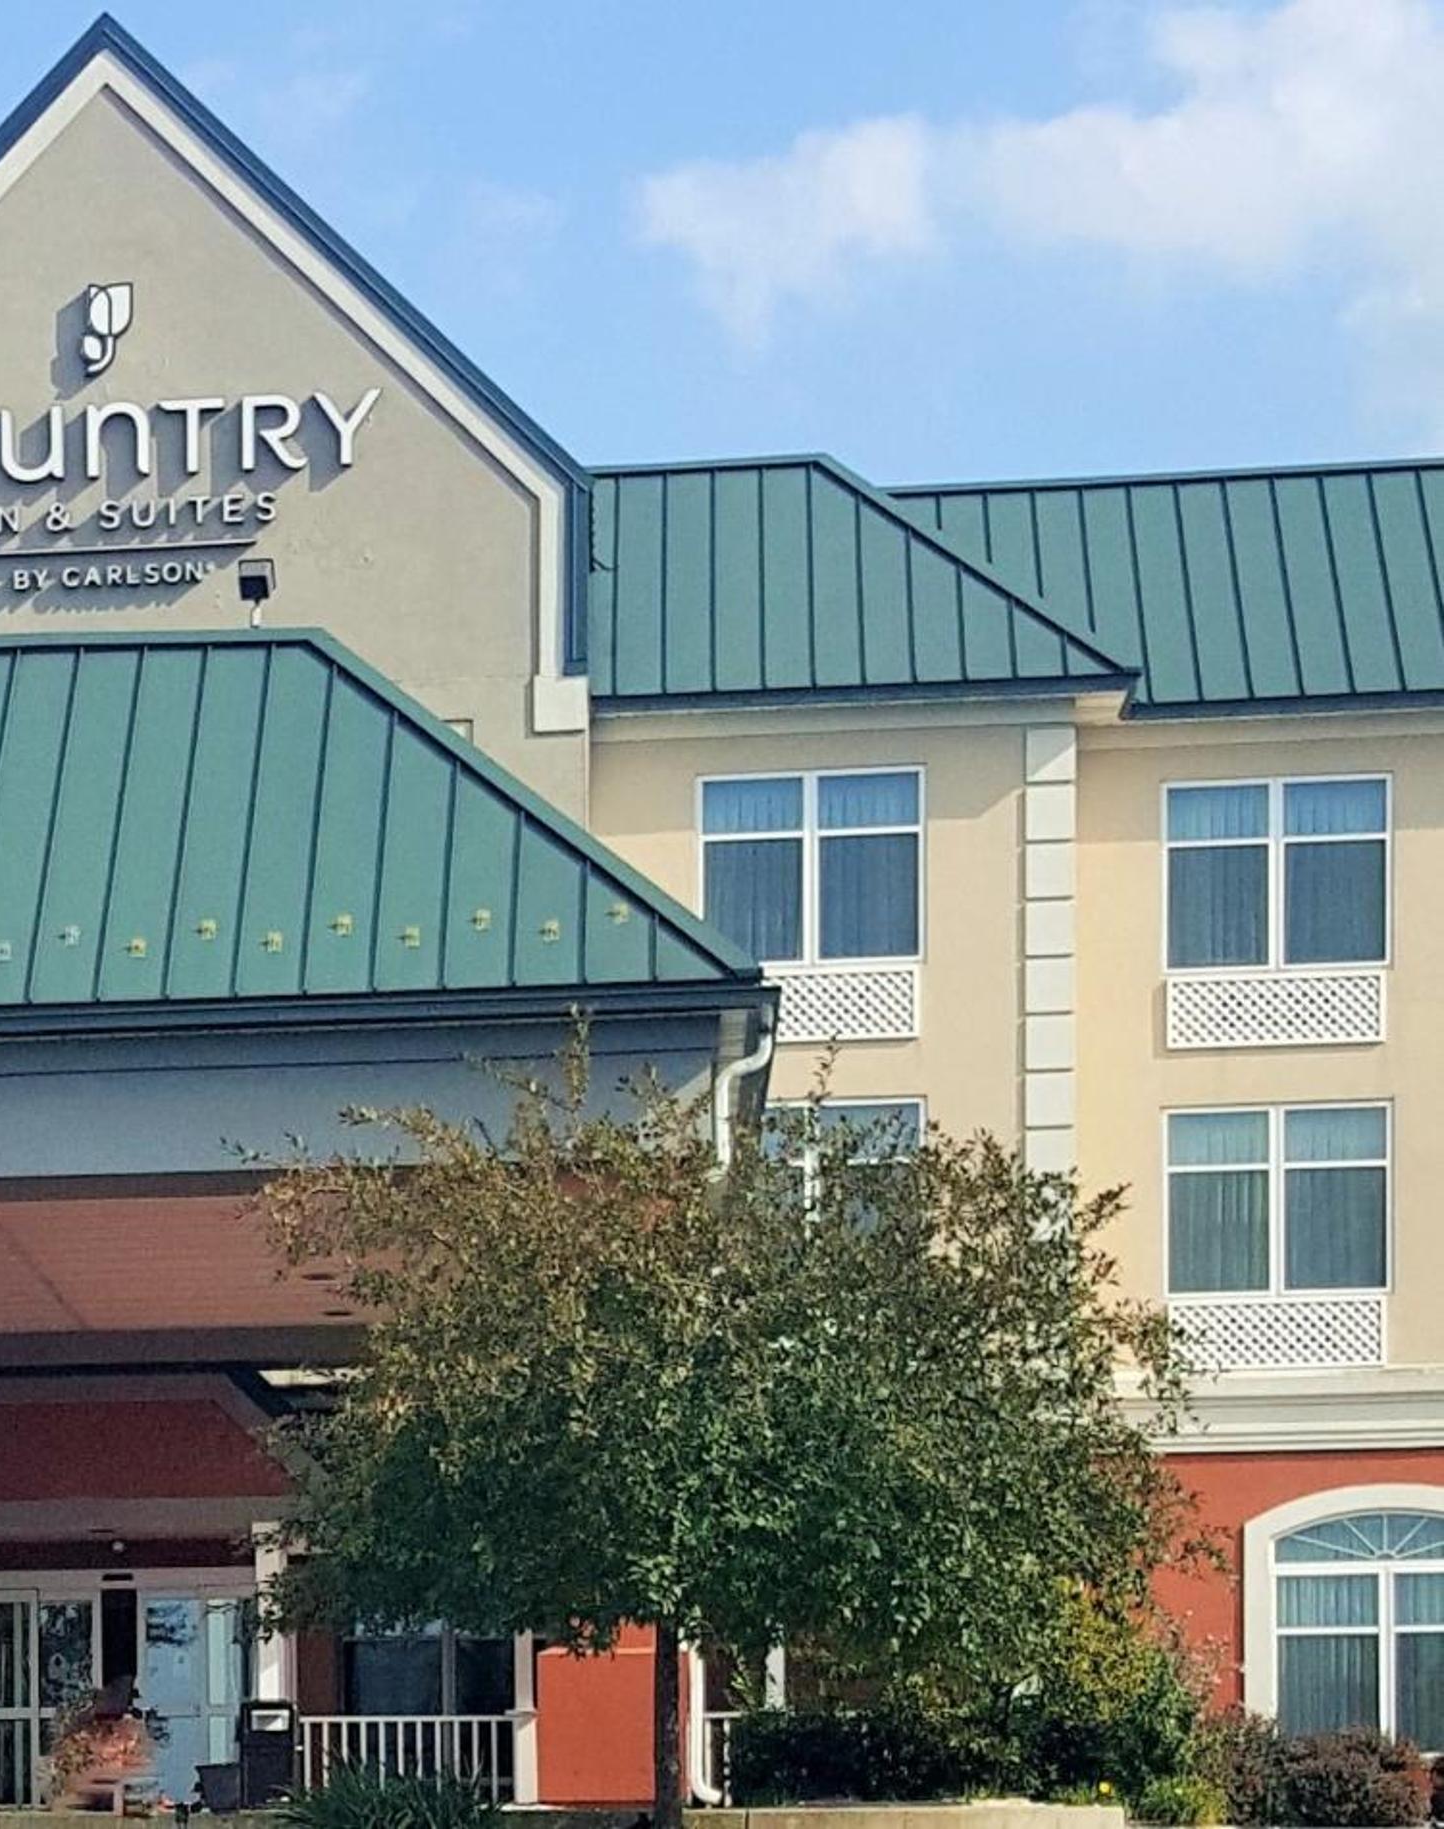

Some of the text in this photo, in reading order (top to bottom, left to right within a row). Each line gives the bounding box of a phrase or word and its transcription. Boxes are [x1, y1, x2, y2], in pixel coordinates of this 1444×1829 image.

[45, 501, 76, 532] &
[99, 491, 276, 530] SUITES
[13, 560, 205, 592] BY CARLSON
